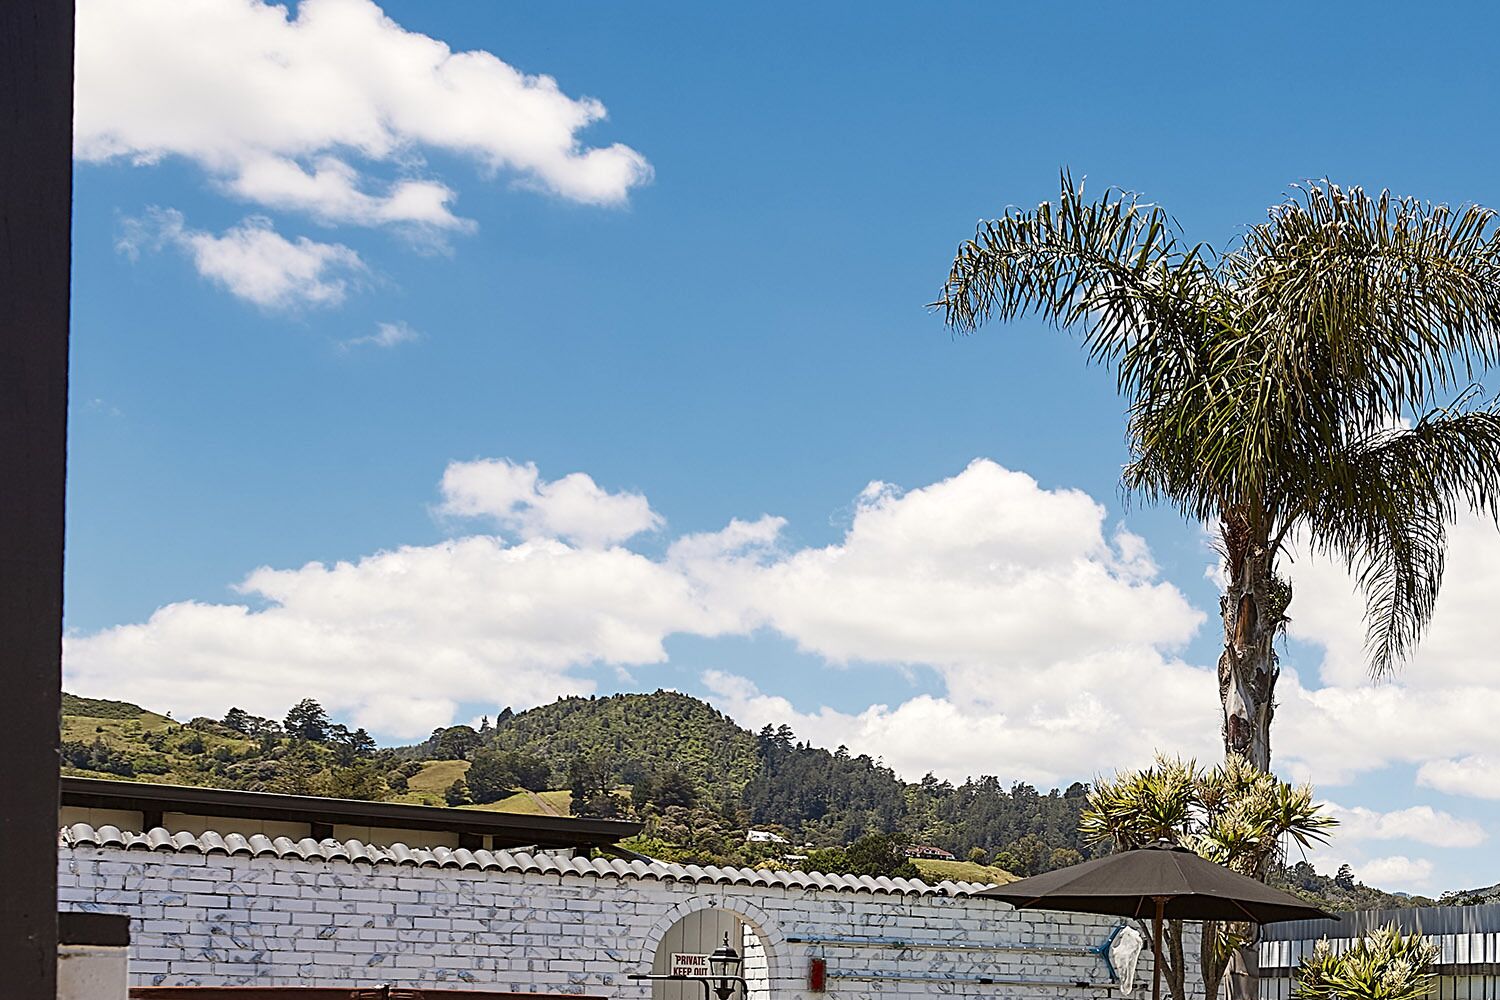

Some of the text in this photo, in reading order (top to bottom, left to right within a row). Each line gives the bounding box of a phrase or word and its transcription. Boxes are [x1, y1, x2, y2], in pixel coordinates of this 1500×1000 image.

[676, 955, 706, 966] PRIVATE
[673, 967, 708, 976] KEEP OUT
